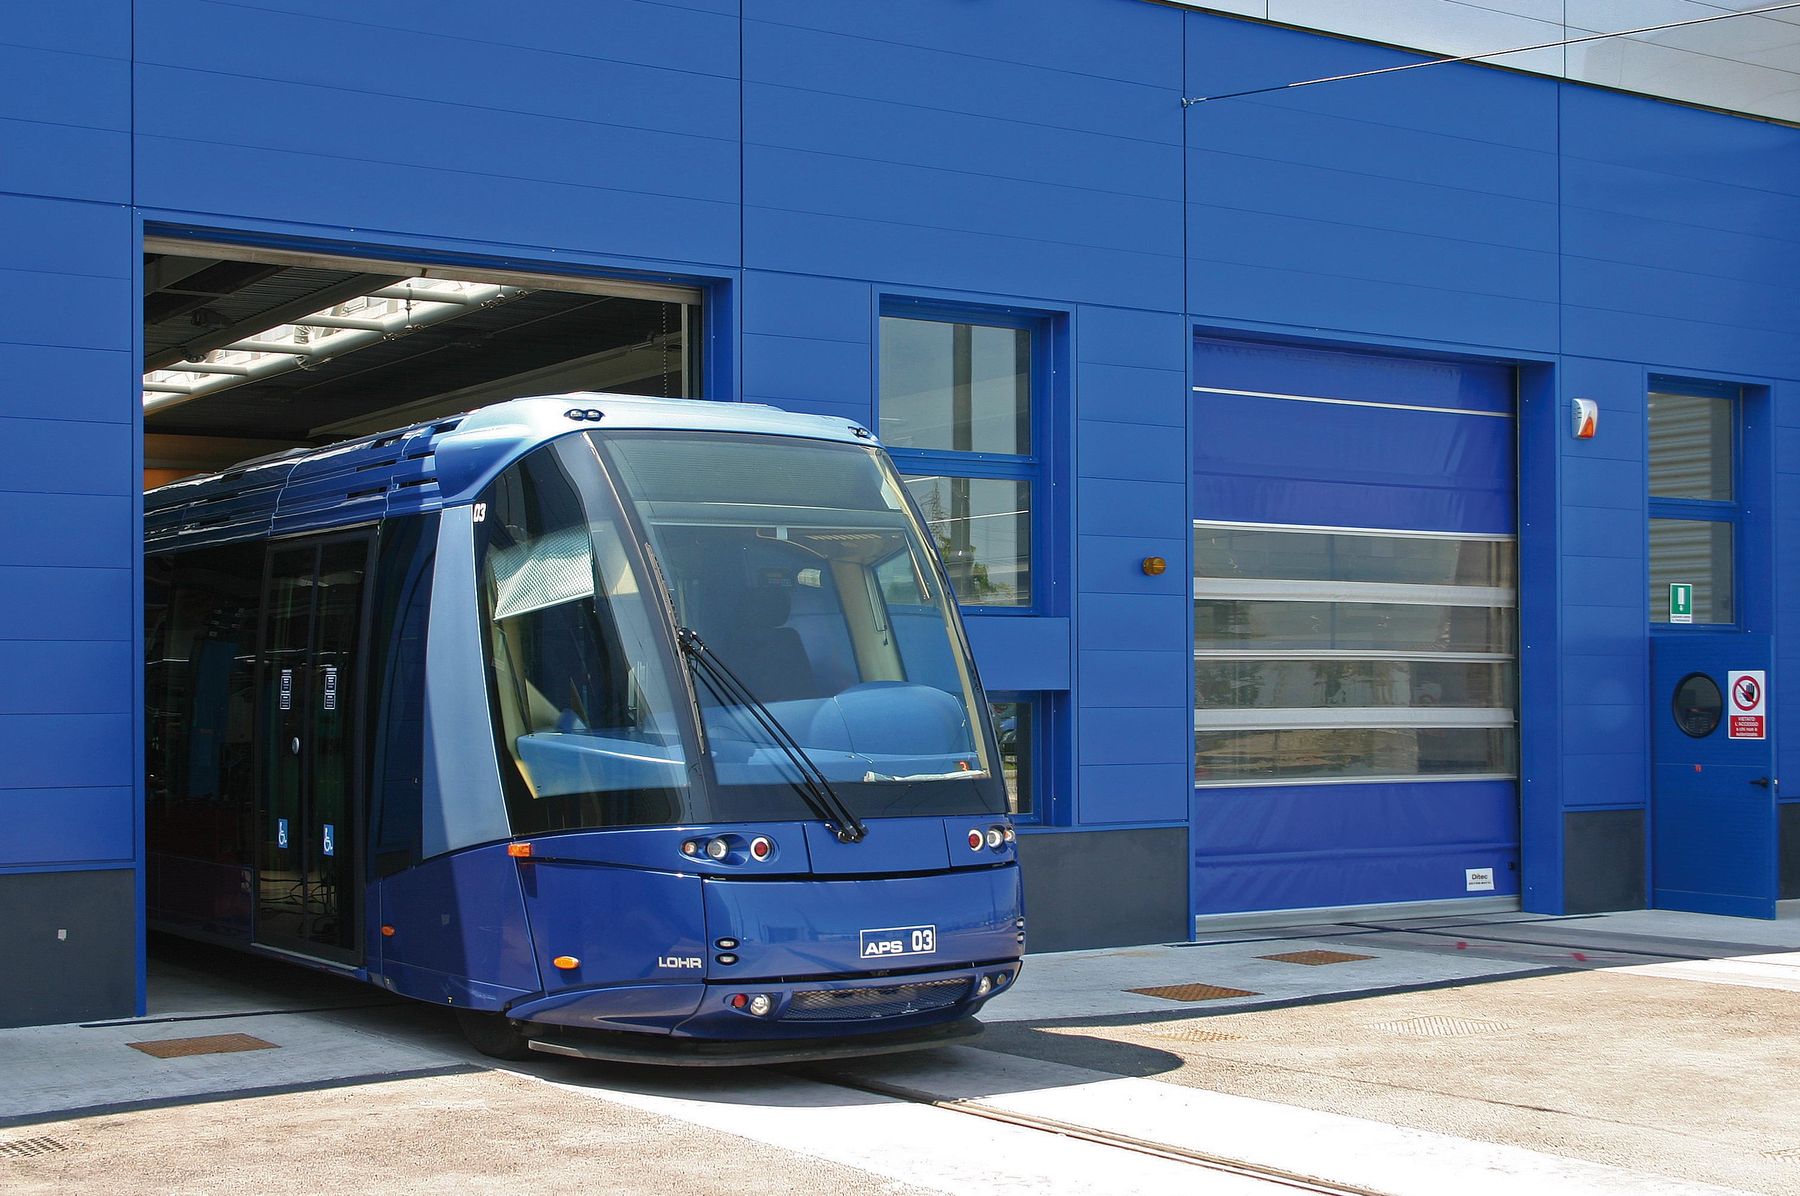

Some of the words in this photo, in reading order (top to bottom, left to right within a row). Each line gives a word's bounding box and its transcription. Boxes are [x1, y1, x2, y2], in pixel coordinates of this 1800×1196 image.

[473, 503, 487, 523] 03
[864, 940, 903, 955] APS
[912, 929, 933, 951] 03
[658, 956, 702, 969] LOHR
